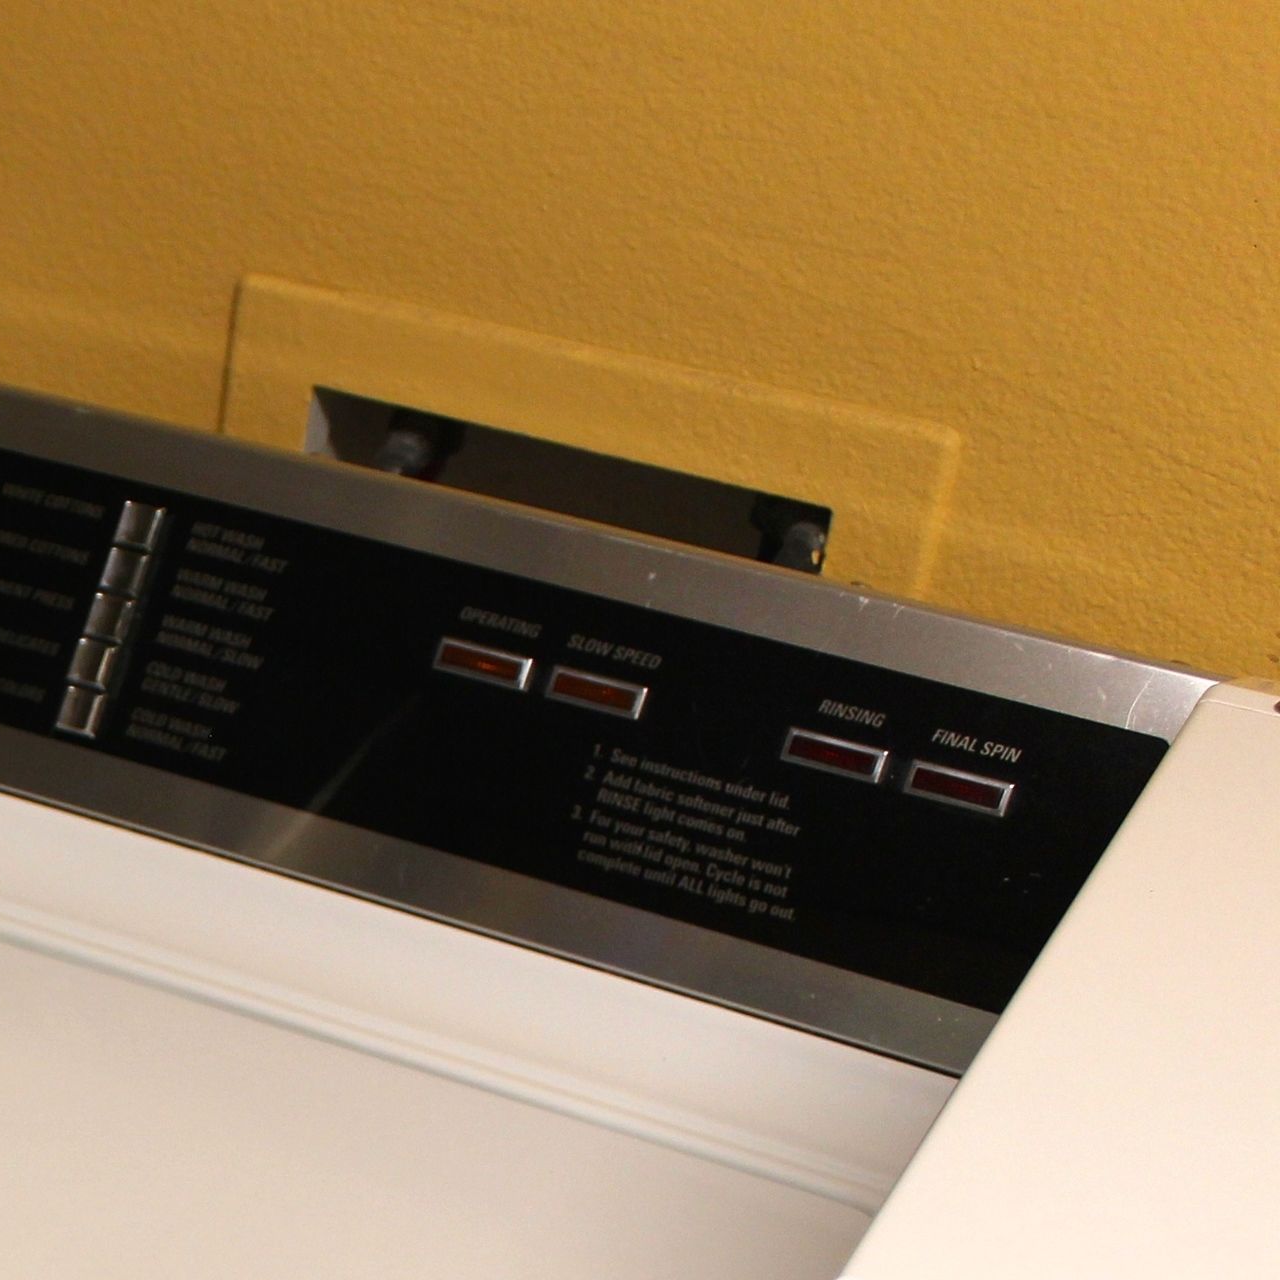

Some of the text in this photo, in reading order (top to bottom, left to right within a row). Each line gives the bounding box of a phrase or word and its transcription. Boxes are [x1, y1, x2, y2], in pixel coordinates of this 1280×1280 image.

[460, 606, 542, 638] OPERATING
[567, 634, 663, 670] SLOW SPEED
[818, 699, 886, 729] RINSING
[931, 728, 1023, 763] FINAL SPIN
[610, 748, 638, 768] See
[640, 757, 722, 791] instructions
[725, 783, 767, 803] under
[596, 788, 642, 813] RINSE
[643, 800, 677, 823] light
[676, 812, 724, 836] comes
[602, 770, 633, 791] Add
[634, 780, 675, 802] fabric
[677, 794, 736, 819] softener
[735, 807, 765, 828] just
[766, 817, 800, 838] after
[582, 831, 607, 847] run
[643, 845, 664, 863] lid
[705, 863, 746, 887] Cycle
[748, 875, 762, 891] is
[763, 883, 789, 899] not
[589, 809, 612, 828] For
[612, 818, 646, 838] your
[695, 842, 749, 867] washer
[751, 857, 792, 880] won't
[576, 849, 643, 879] complete
[643, 865, 677, 886] until
[677, 876, 705, 895] ALL
[707, 884, 747, 908] lights
[748, 899, 768, 915] go
